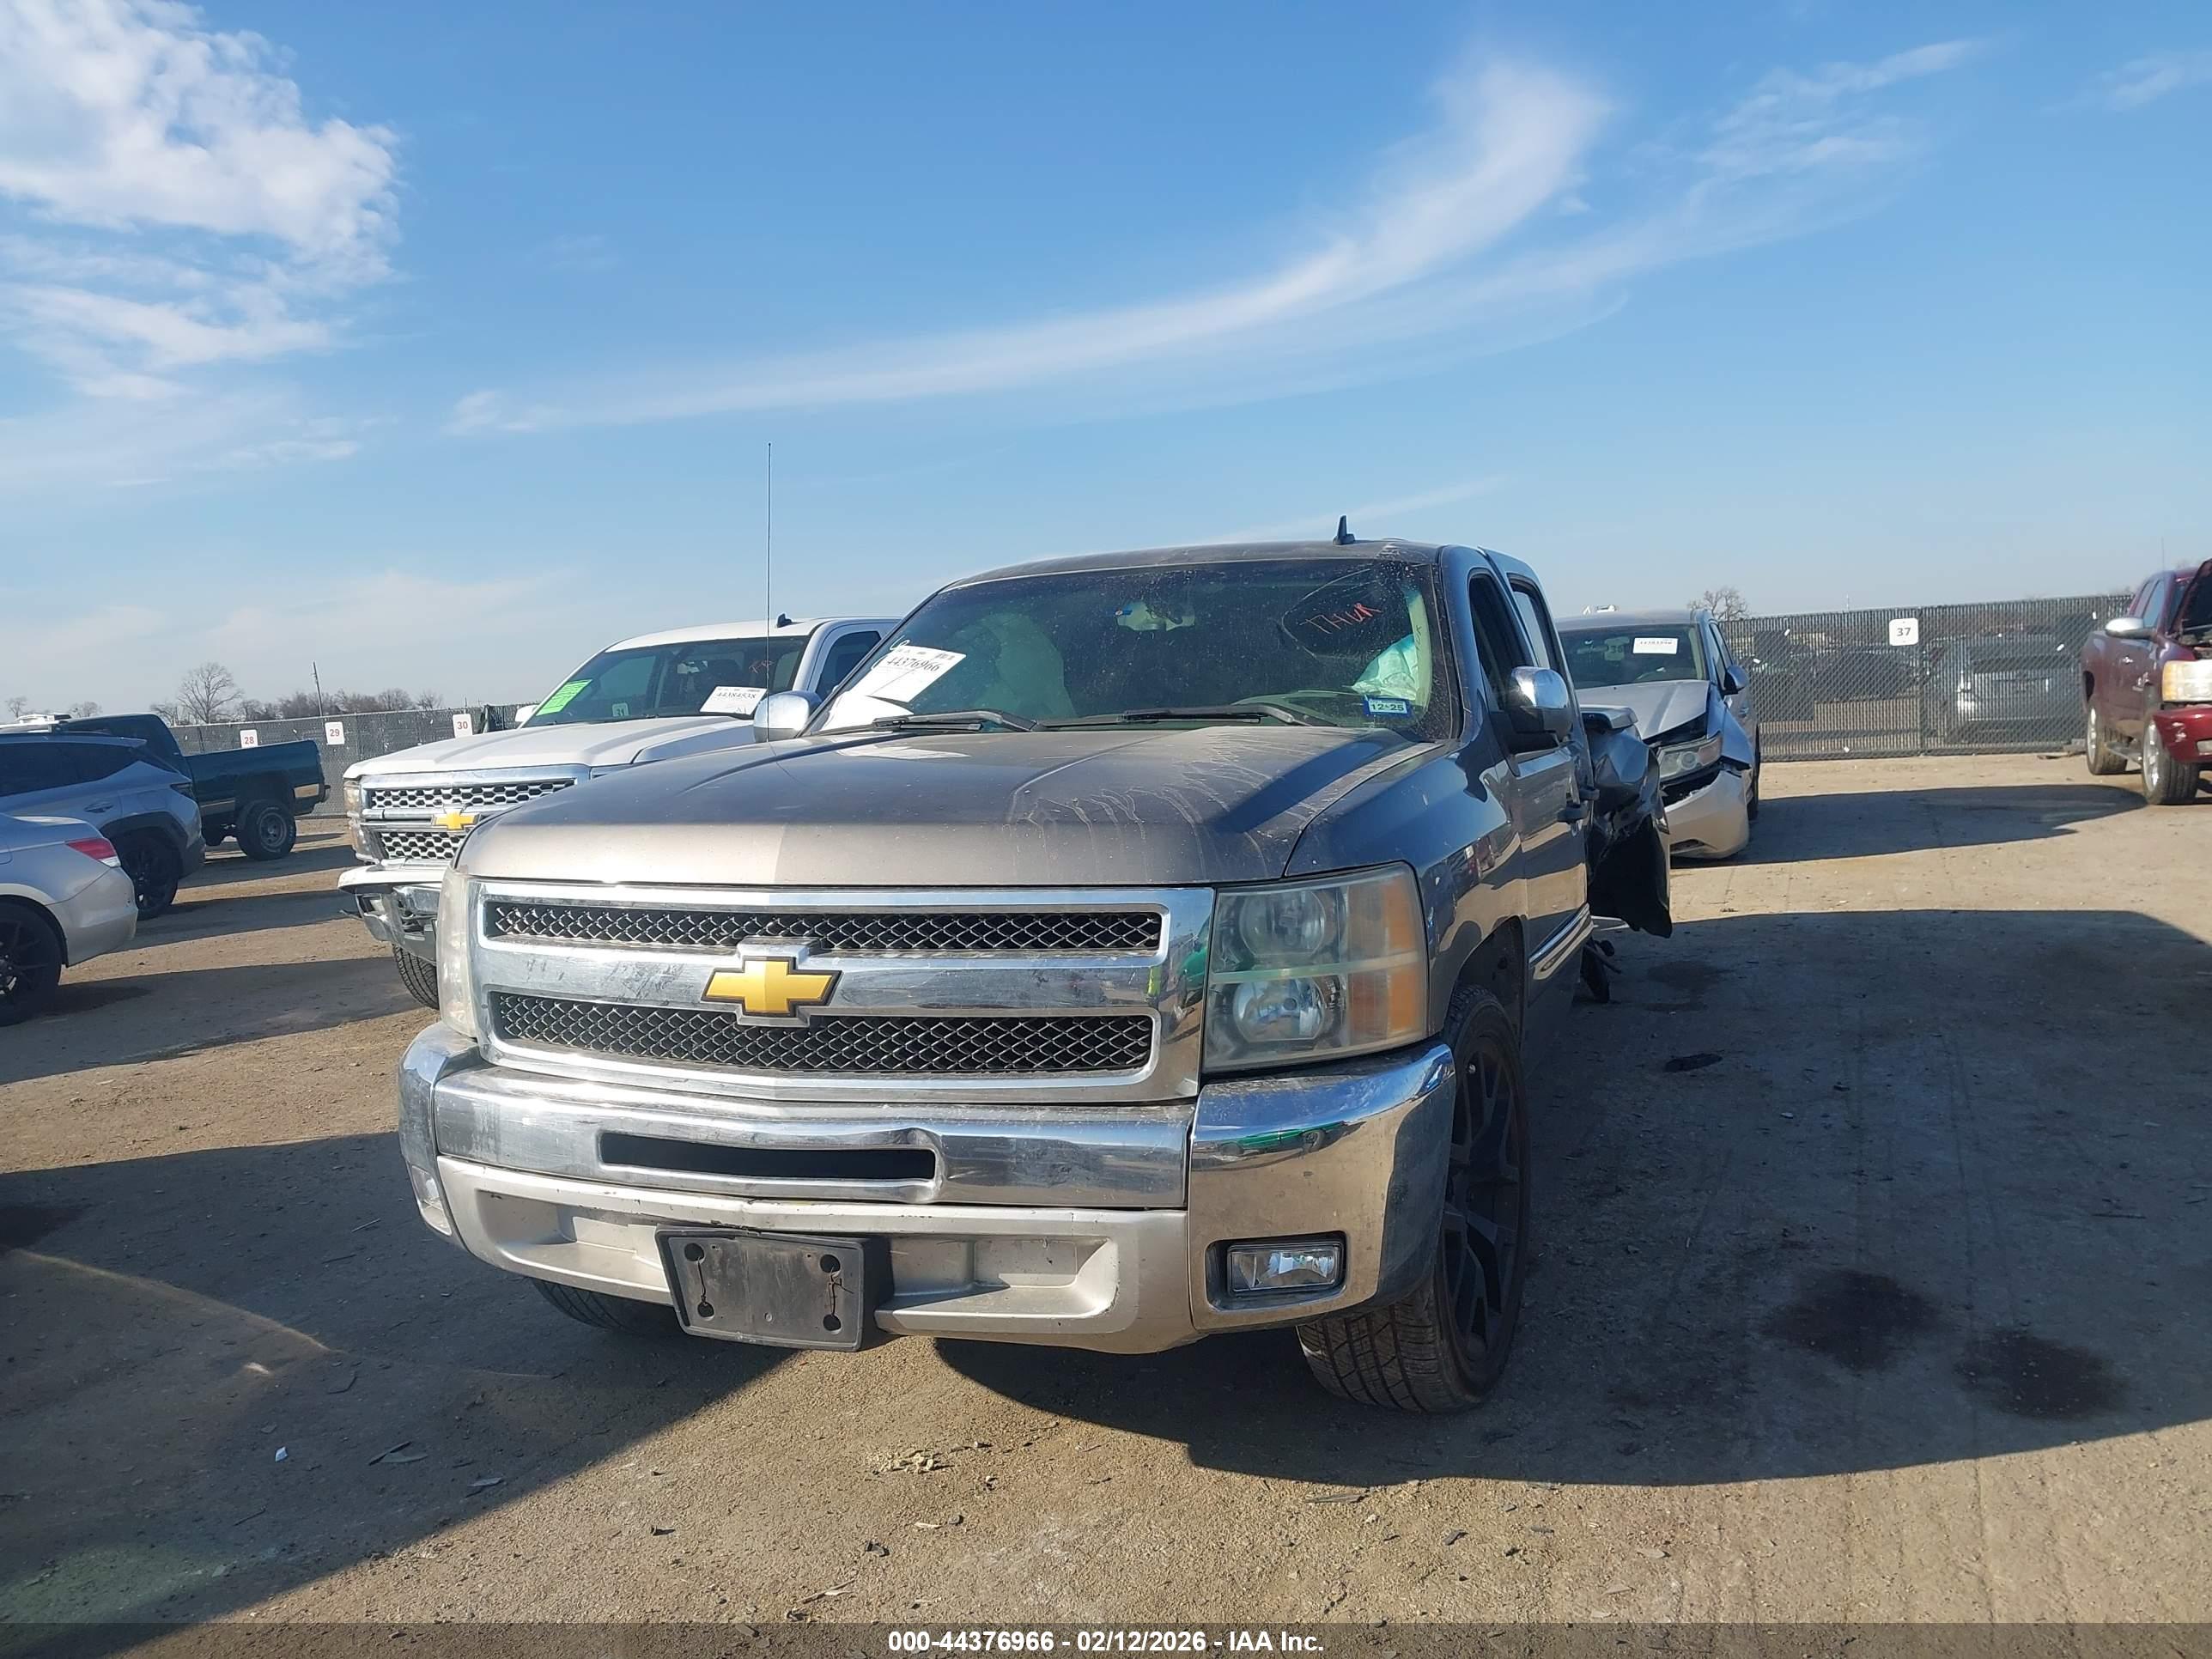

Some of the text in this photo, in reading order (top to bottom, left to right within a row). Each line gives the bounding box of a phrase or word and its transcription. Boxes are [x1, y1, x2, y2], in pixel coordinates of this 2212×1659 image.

[1896, 627, 1911, 637] 37
[887, 655, 942, 672] 44376966
[457, 721, 469, 730] 30
[329, 728, 340, 737] 29
[244, 737, 255, 745] 28
